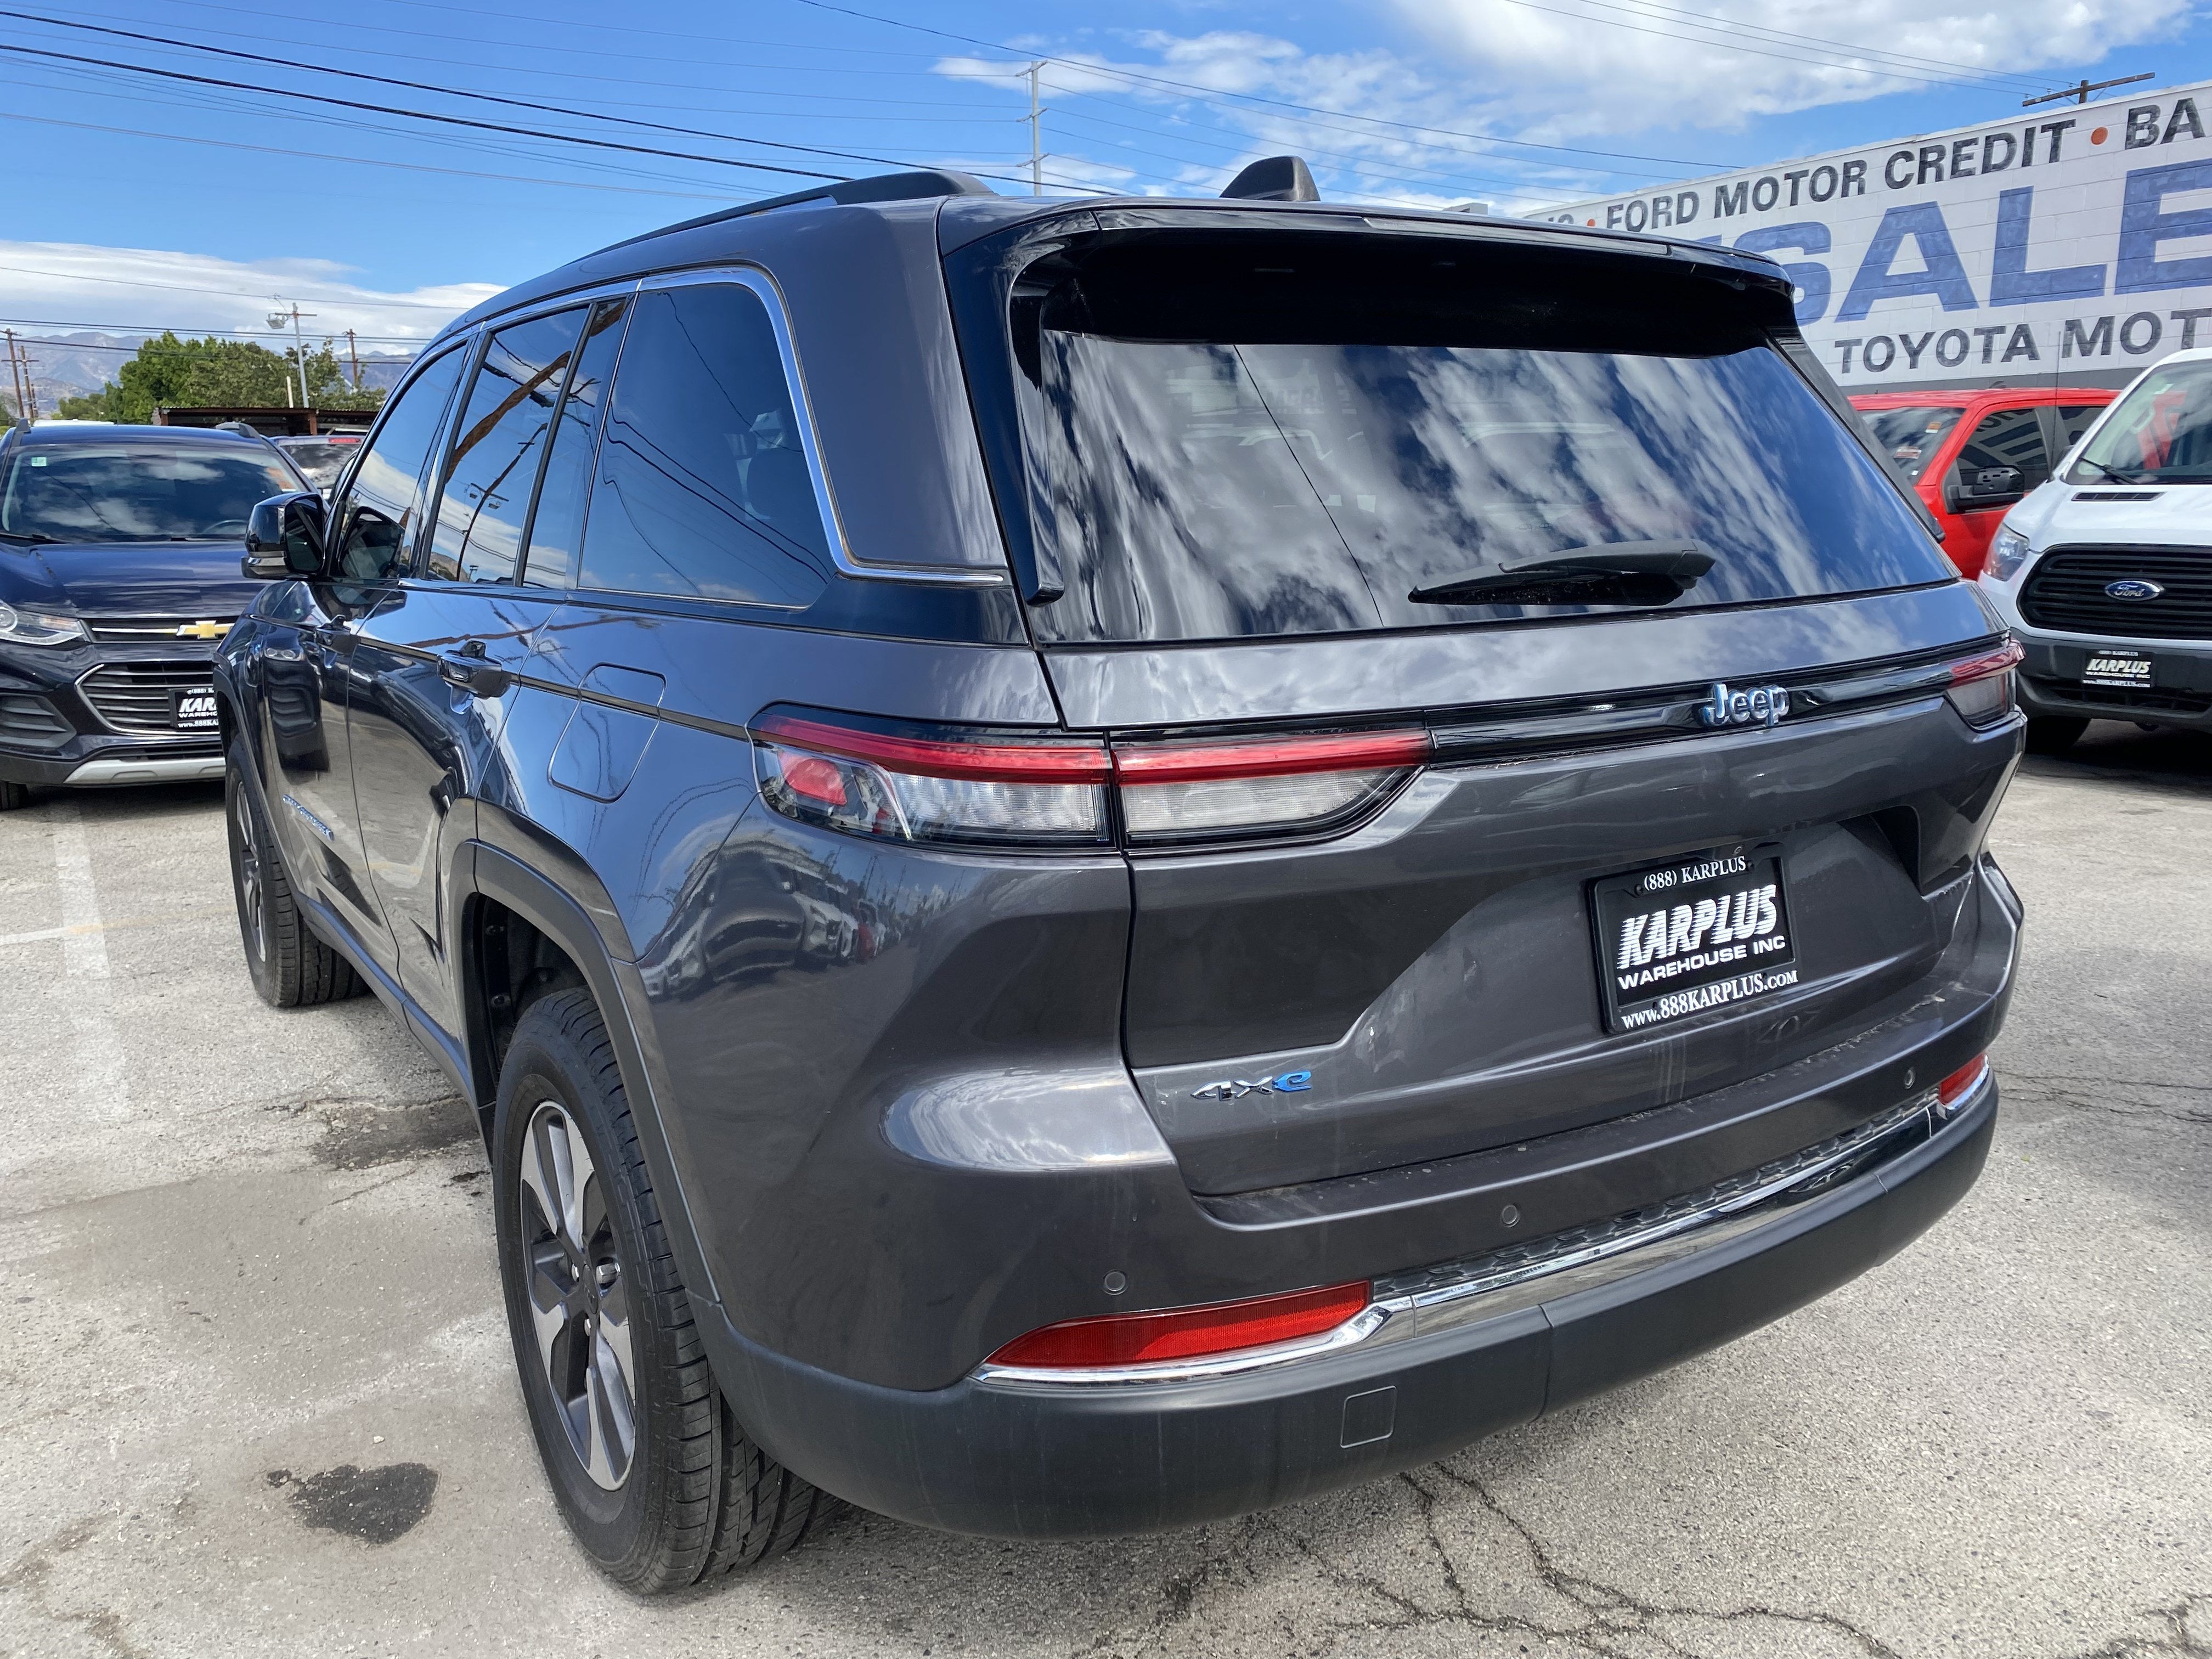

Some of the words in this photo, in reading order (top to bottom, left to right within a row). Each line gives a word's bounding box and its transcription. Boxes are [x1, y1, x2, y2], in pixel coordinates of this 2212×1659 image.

[1607, 191, 1700, 232] FORD
[1714, 160, 1866, 219] MOTOR
[1884, 119, 2076, 189] CREDIT
[2125, 97, 2206, 150] BA
[1835, 325, 2040, 373] TOYOTA
[2114, 584, 2146, 597] Ford
[2086, 659, 2151, 674] KARPLUS
[1702, 684, 1790, 726] Jeep
[1644, 870, 1677, 891] (888)
[1681, 856, 1746, 883] KARPLUS
[1617, 884, 1777, 970] KARPLUS
[1618, 944, 1748, 990] WAREHOUSE
[1753, 935, 1786, 955] INC
